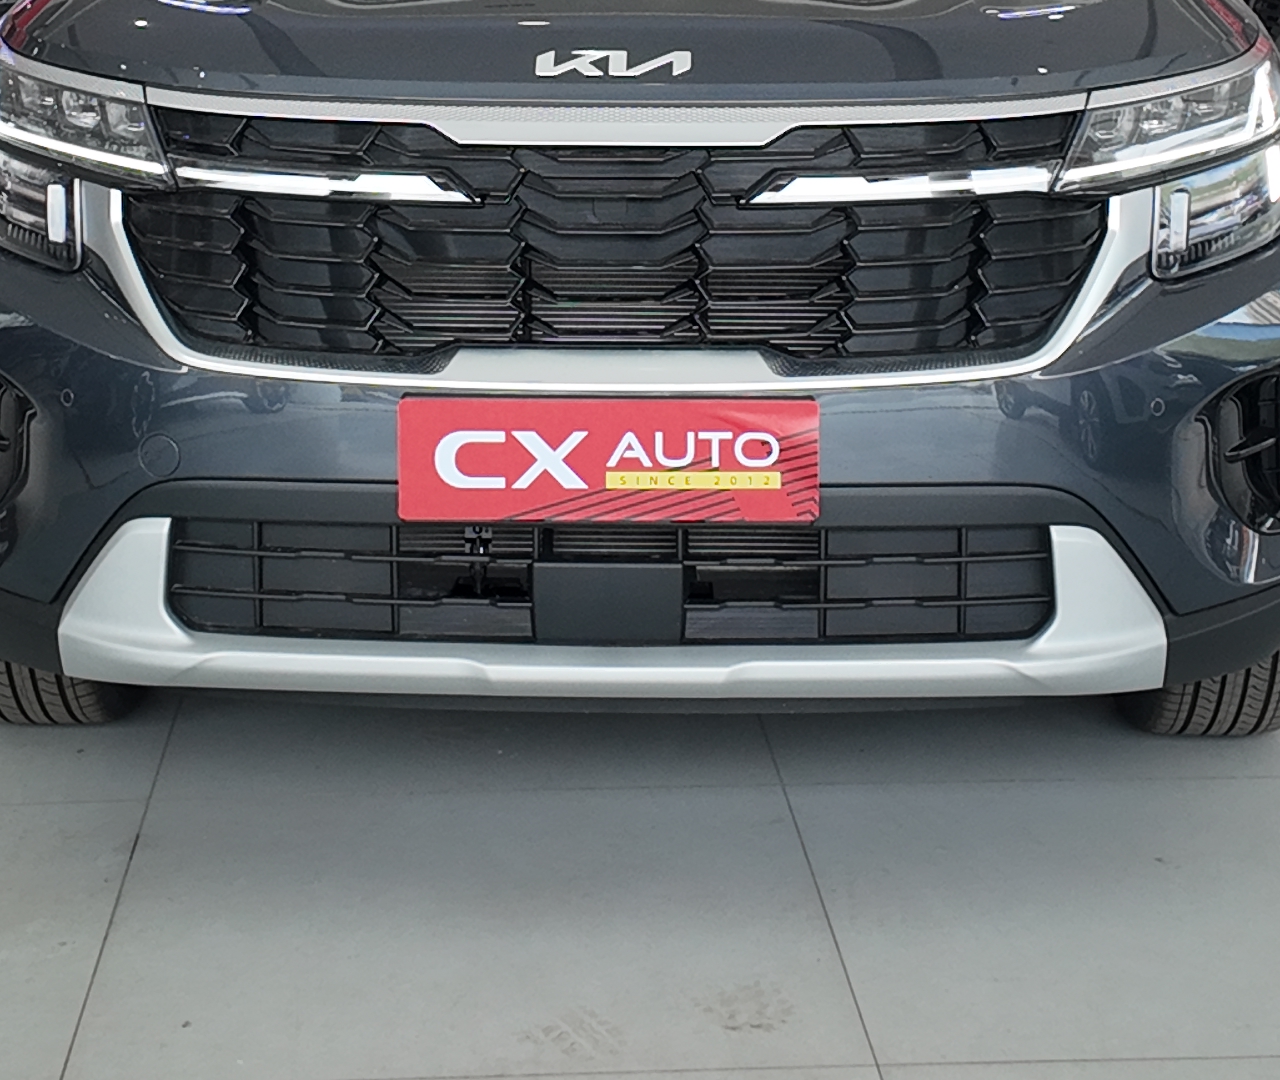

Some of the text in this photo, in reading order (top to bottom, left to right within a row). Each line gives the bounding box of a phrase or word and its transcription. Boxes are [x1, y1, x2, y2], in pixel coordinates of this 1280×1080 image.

[534, 49, 693, 77] KIA
[433, 430, 782, 490] CX AUTO
[619, 475, 772, 487] SINCE 2012
